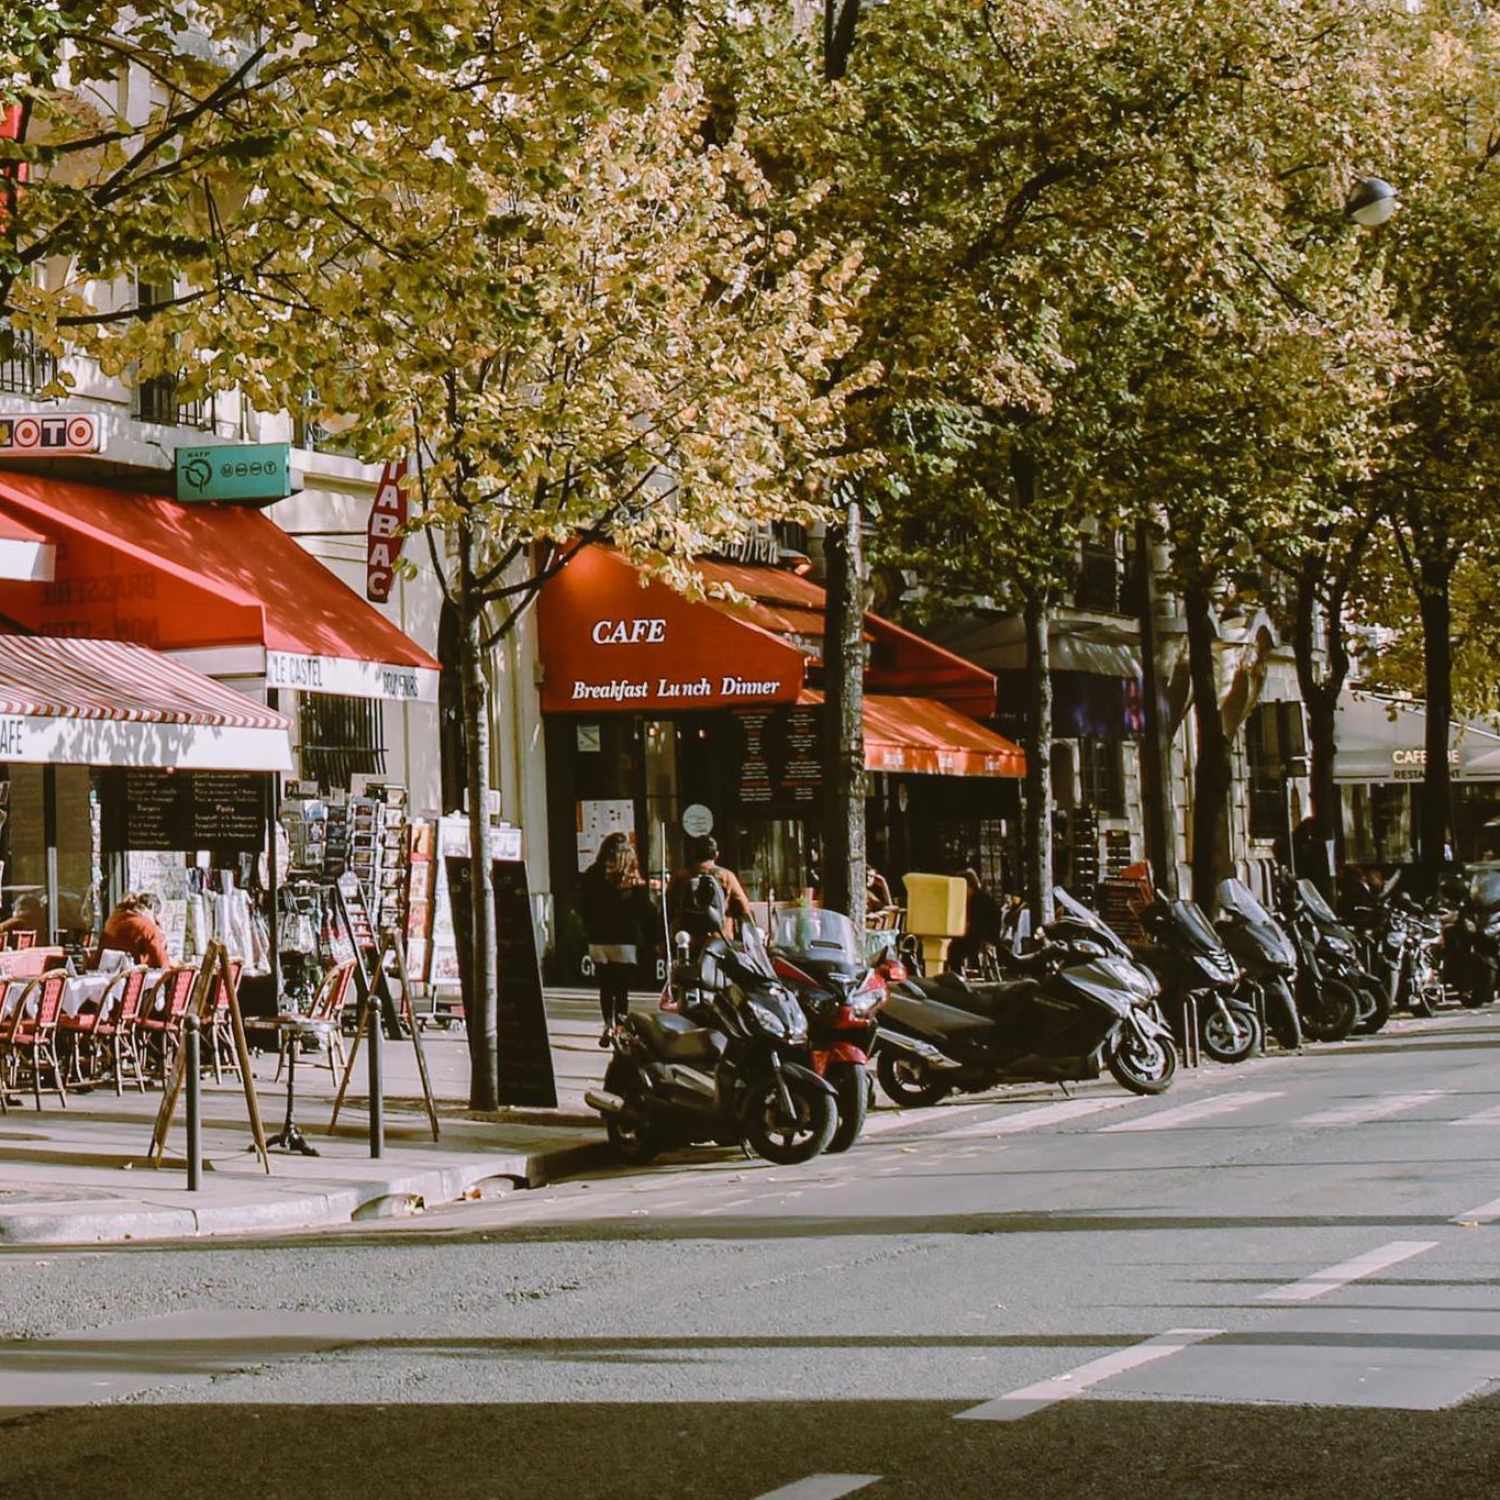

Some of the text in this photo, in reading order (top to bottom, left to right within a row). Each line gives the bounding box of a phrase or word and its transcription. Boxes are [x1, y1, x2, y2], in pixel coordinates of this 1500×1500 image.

[592, 619, 667, 645] CAFE
[290, 658, 324, 688] CASTEL
[572, 676, 781, 702] Breakfast Lunch Dinner
